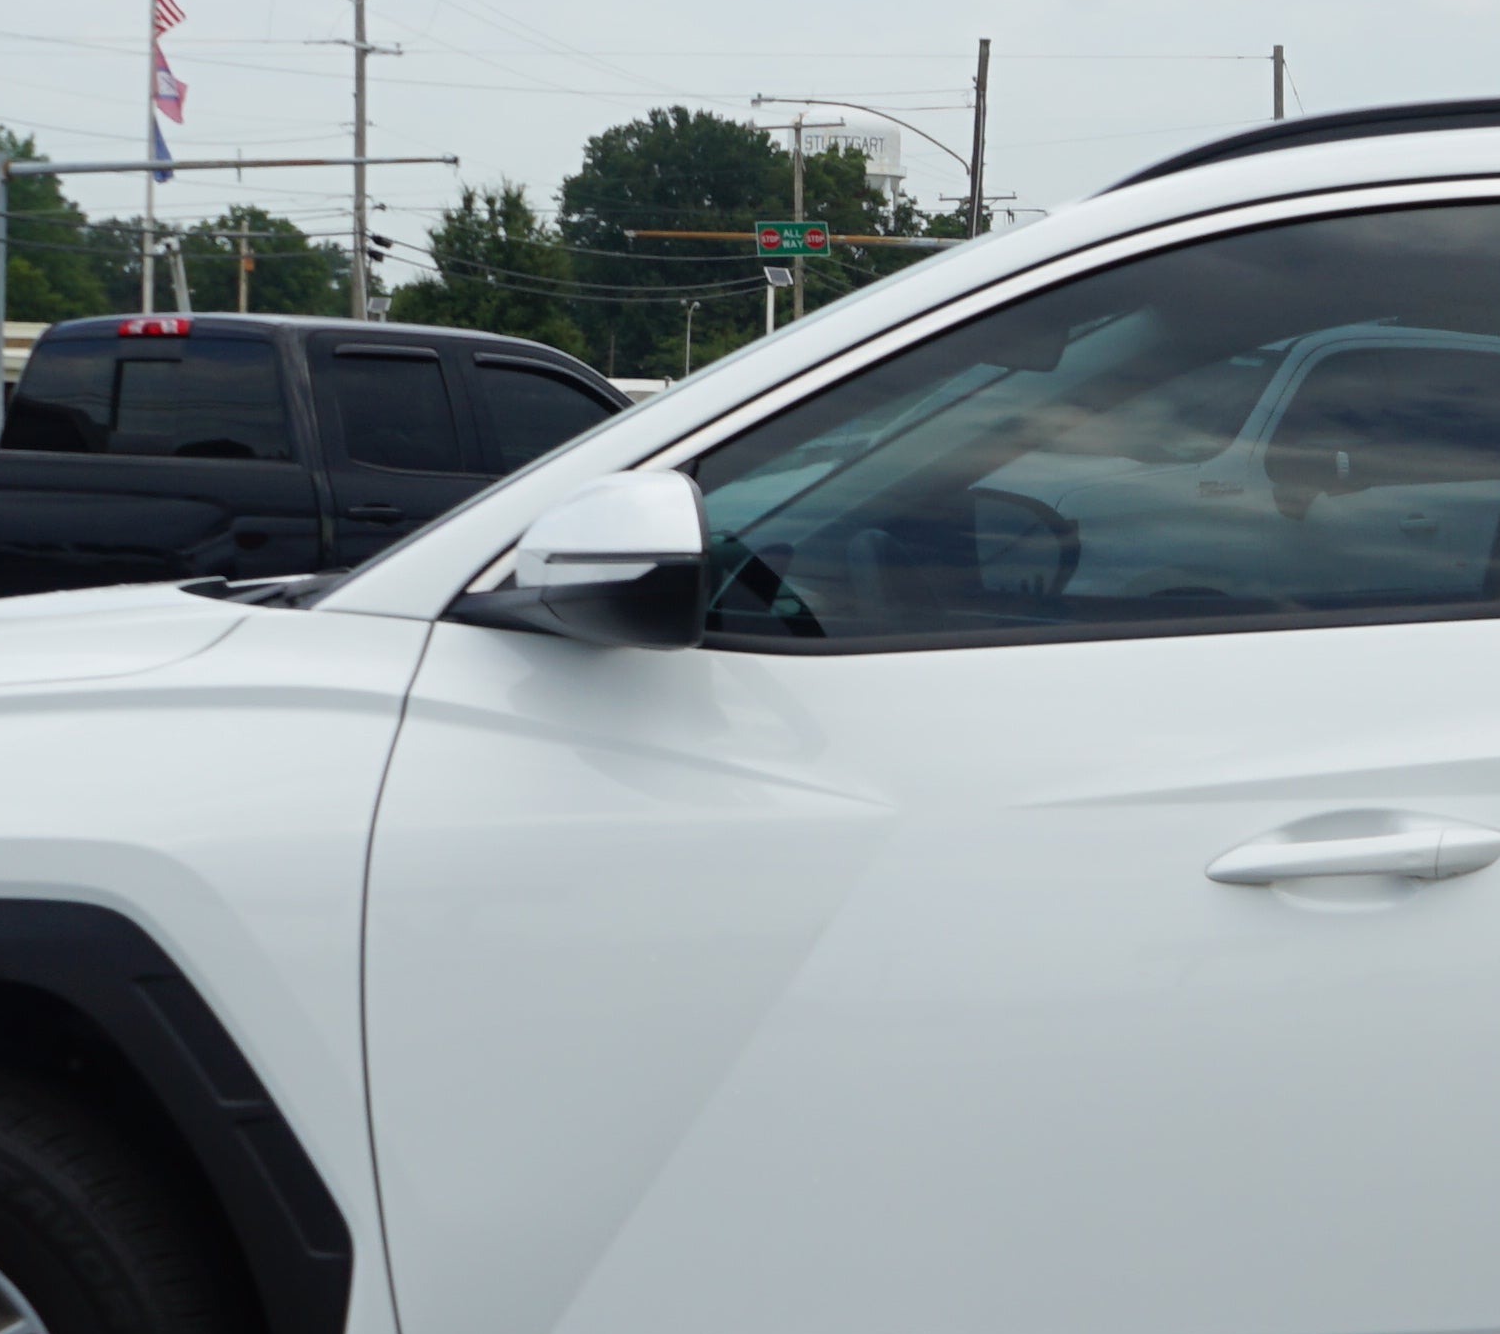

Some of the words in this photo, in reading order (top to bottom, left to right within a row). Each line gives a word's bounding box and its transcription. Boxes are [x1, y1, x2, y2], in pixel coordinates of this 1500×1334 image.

[783, 229, 802, 238] ALL
[761, 235, 780, 243] STOP
[806, 235, 825, 243] STOP
[782, 240, 804, 249] WAY
